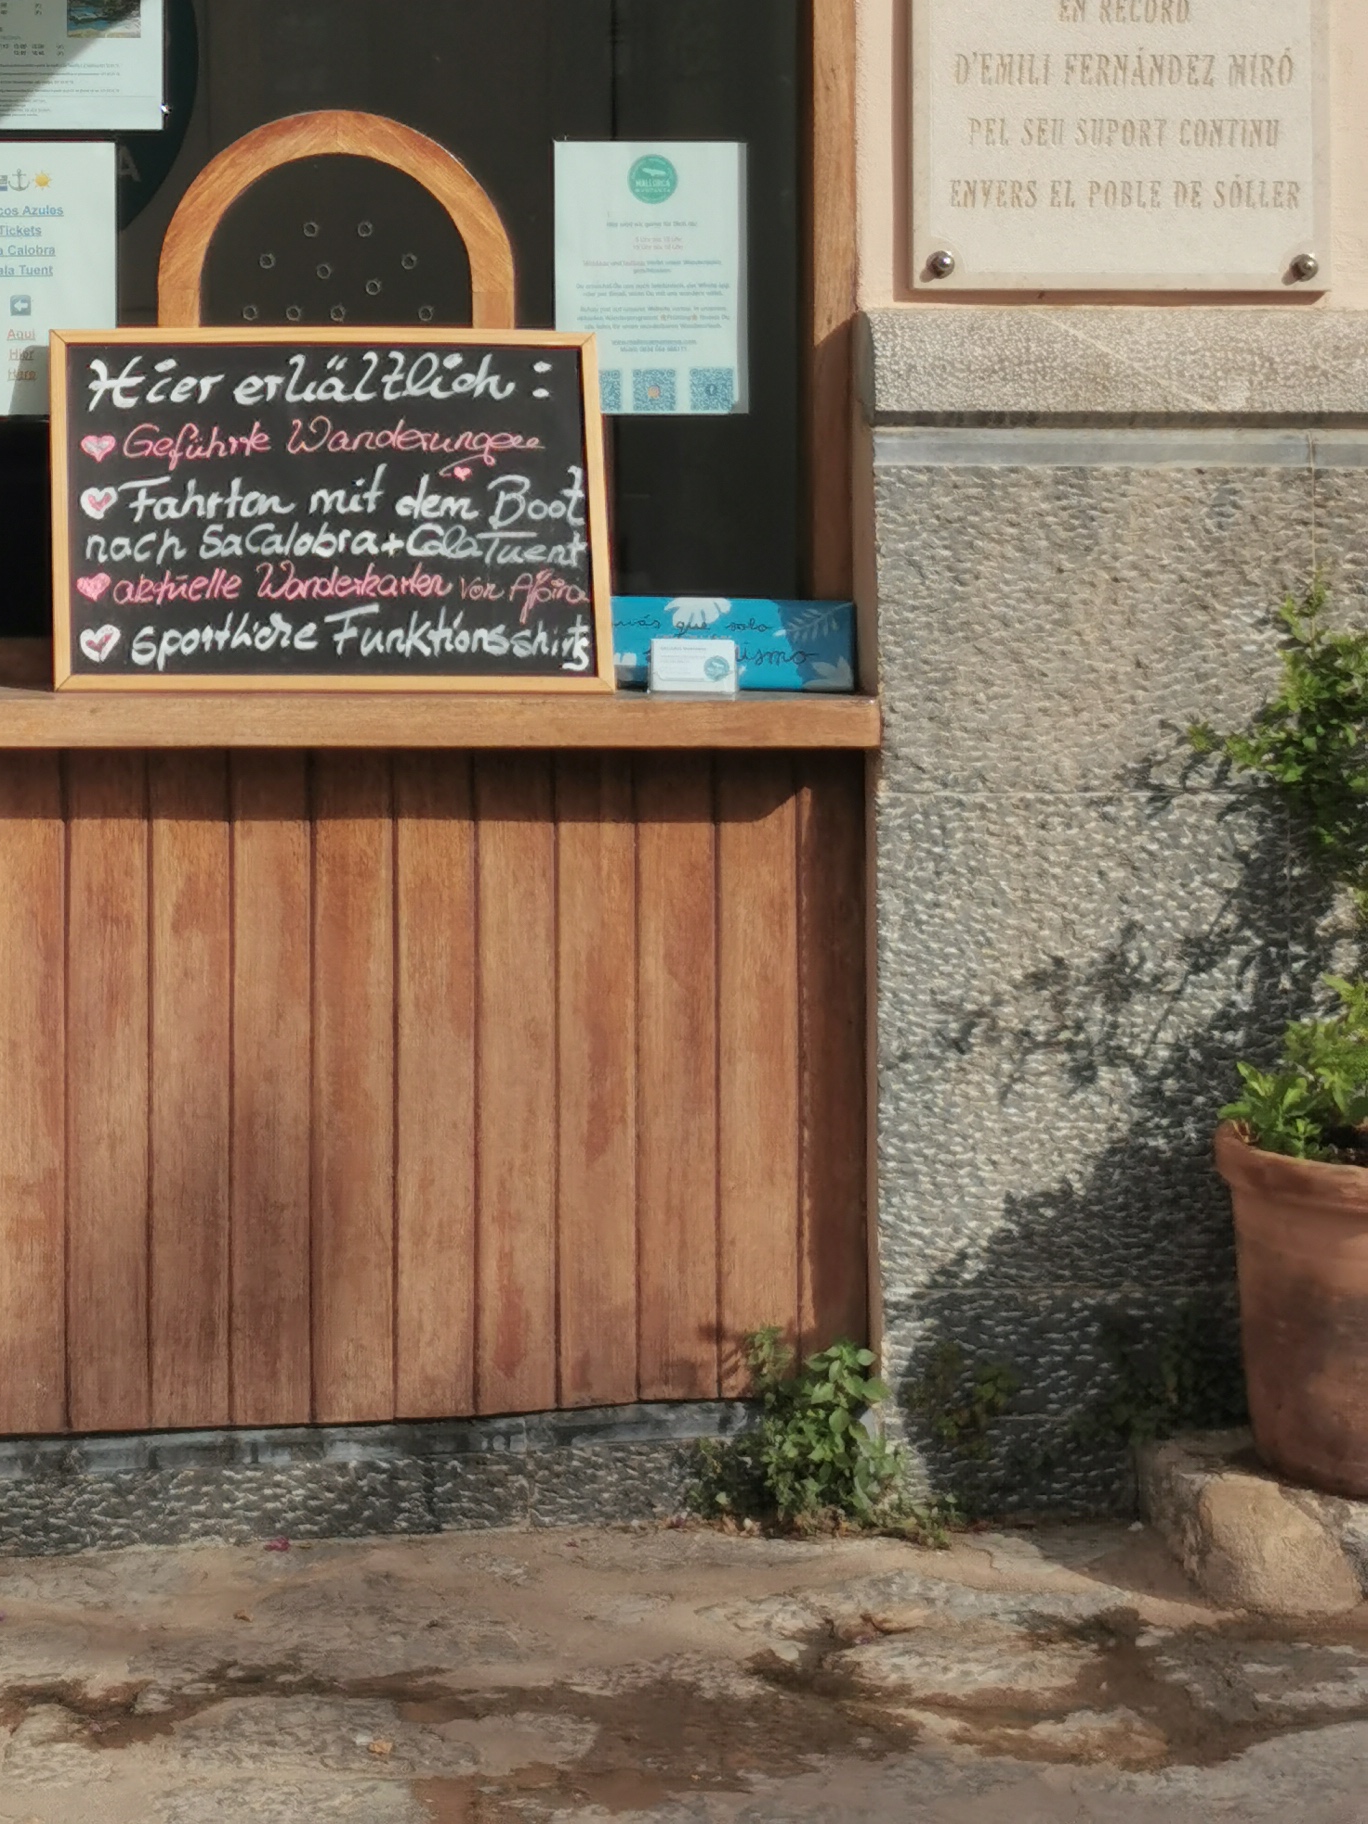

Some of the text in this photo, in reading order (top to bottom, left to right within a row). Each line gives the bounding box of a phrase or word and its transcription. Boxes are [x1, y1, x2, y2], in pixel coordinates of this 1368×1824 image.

[954, 47, 1294, 87] D'EMILI FERNÁNDEZ MIRÓ
[968, 117, 1280, 148] PEL SEU SUPORT CONTINU
[22, 204, 64, 217] Azules
[949, 173, 1300, 210] ENVERS EL POBLE DE SÓLLER
[7, 244, 56, 257] Calobra
[18, 265, 53, 277] Tuent
[88, 355, 225, 412] Hier
[233, 350, 516, 406] erhältlich
[122, 415, 546, 473] Geführte Wanderungen
[117, 463, 585, 529] Fahrten mit dem Boot
[85, 528, 187, 565] nach
[113, 566, 243, 605] aktuelle
[256, 559, 454, 602] Wanderkarten
[323, 602, 590, 671] Funktionsshirts
